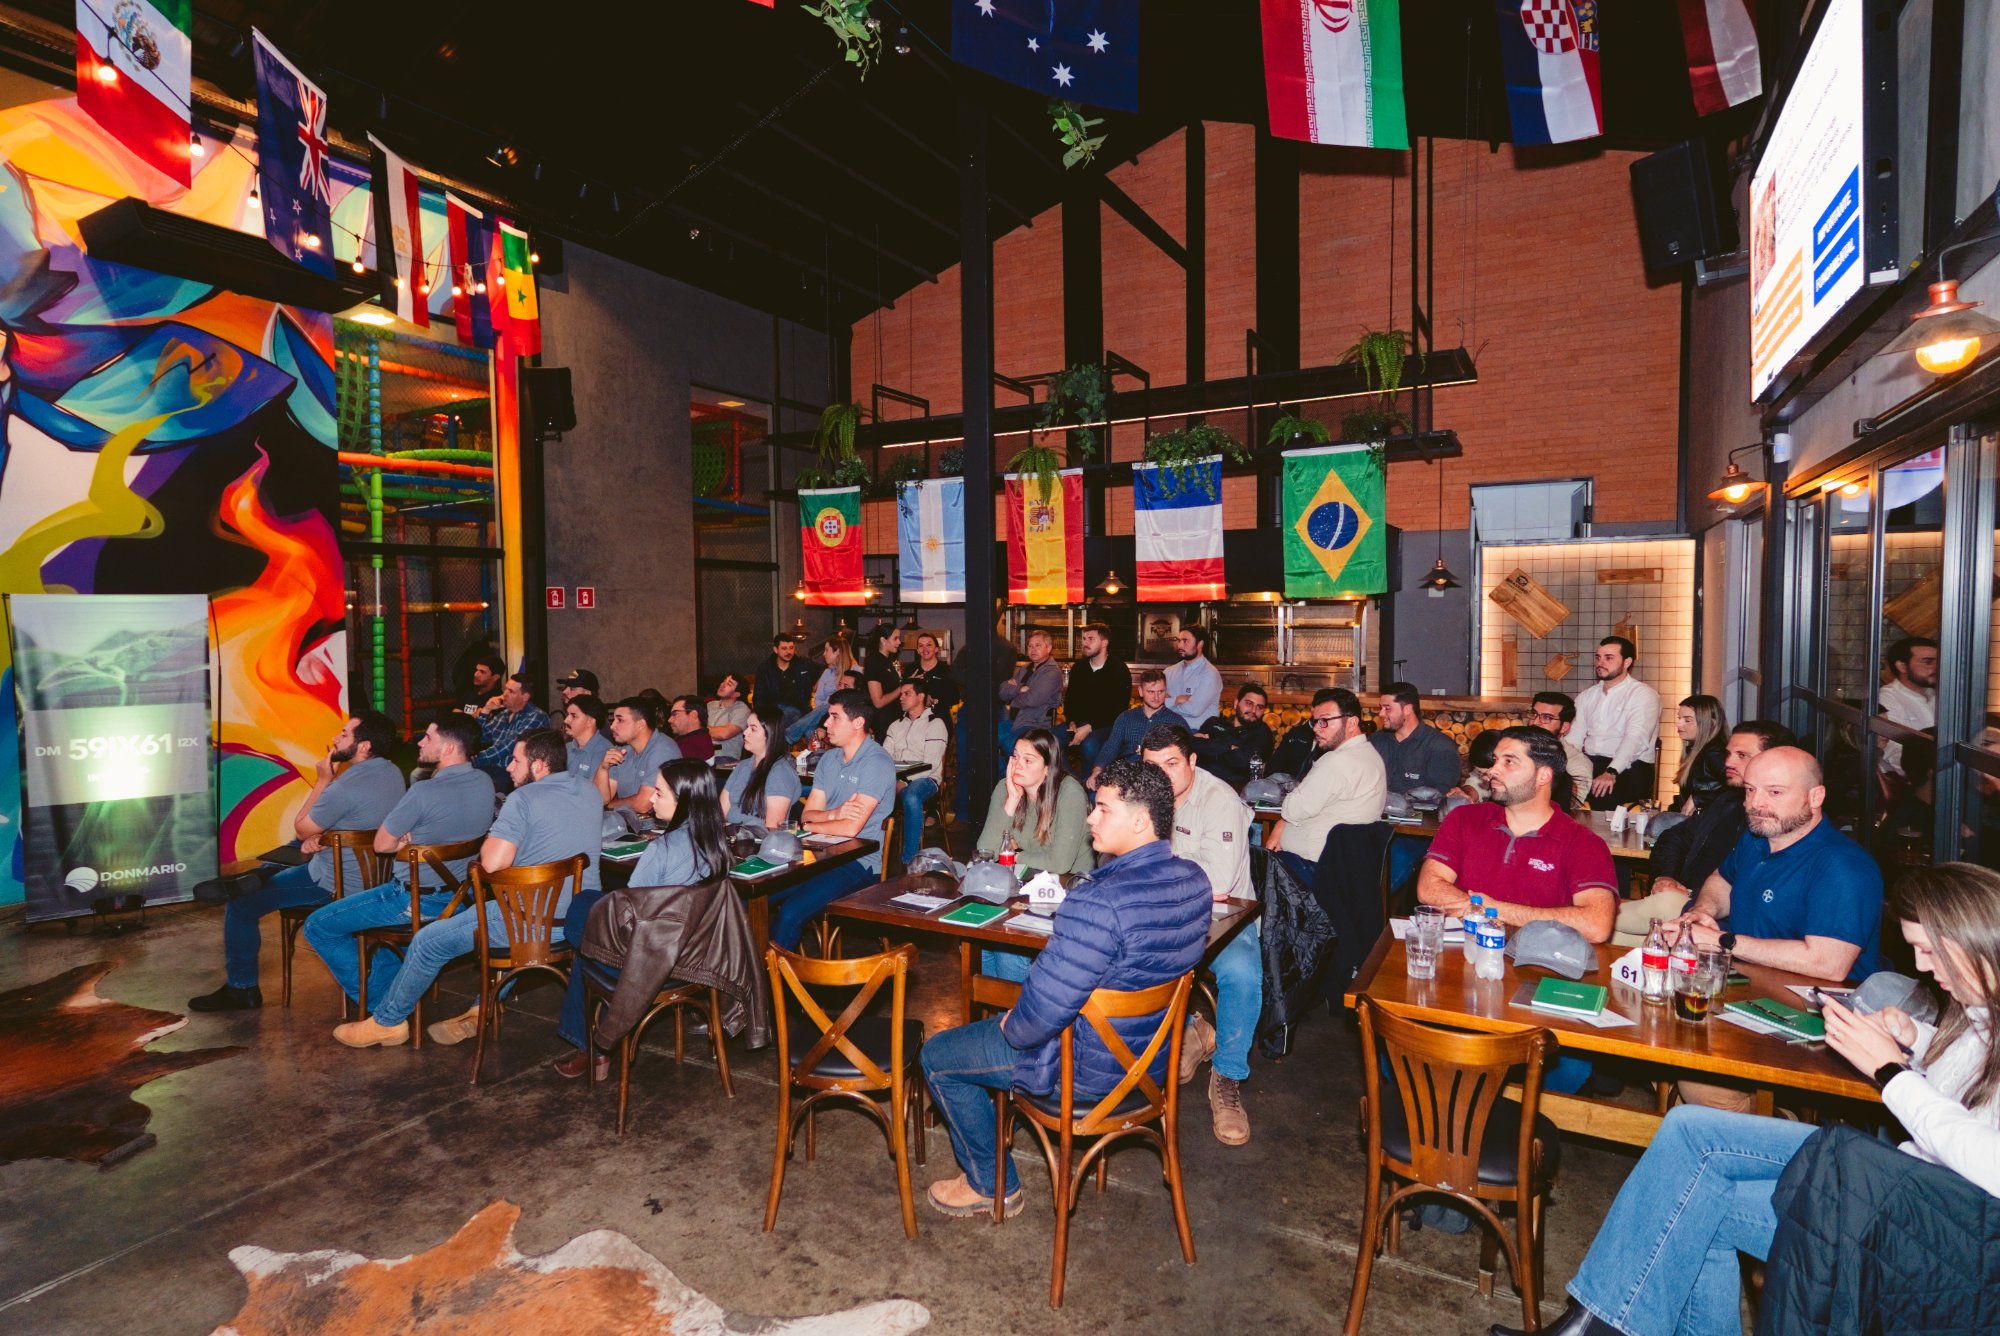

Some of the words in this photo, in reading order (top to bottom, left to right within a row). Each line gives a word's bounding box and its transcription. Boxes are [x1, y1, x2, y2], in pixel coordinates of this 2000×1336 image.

[35, 745, 61, 757] DM
[100, 862, 187, 882] DONMARIO
[1038, 887, 1055, 899] 60
[1621, 965, 1637, 983] 61
